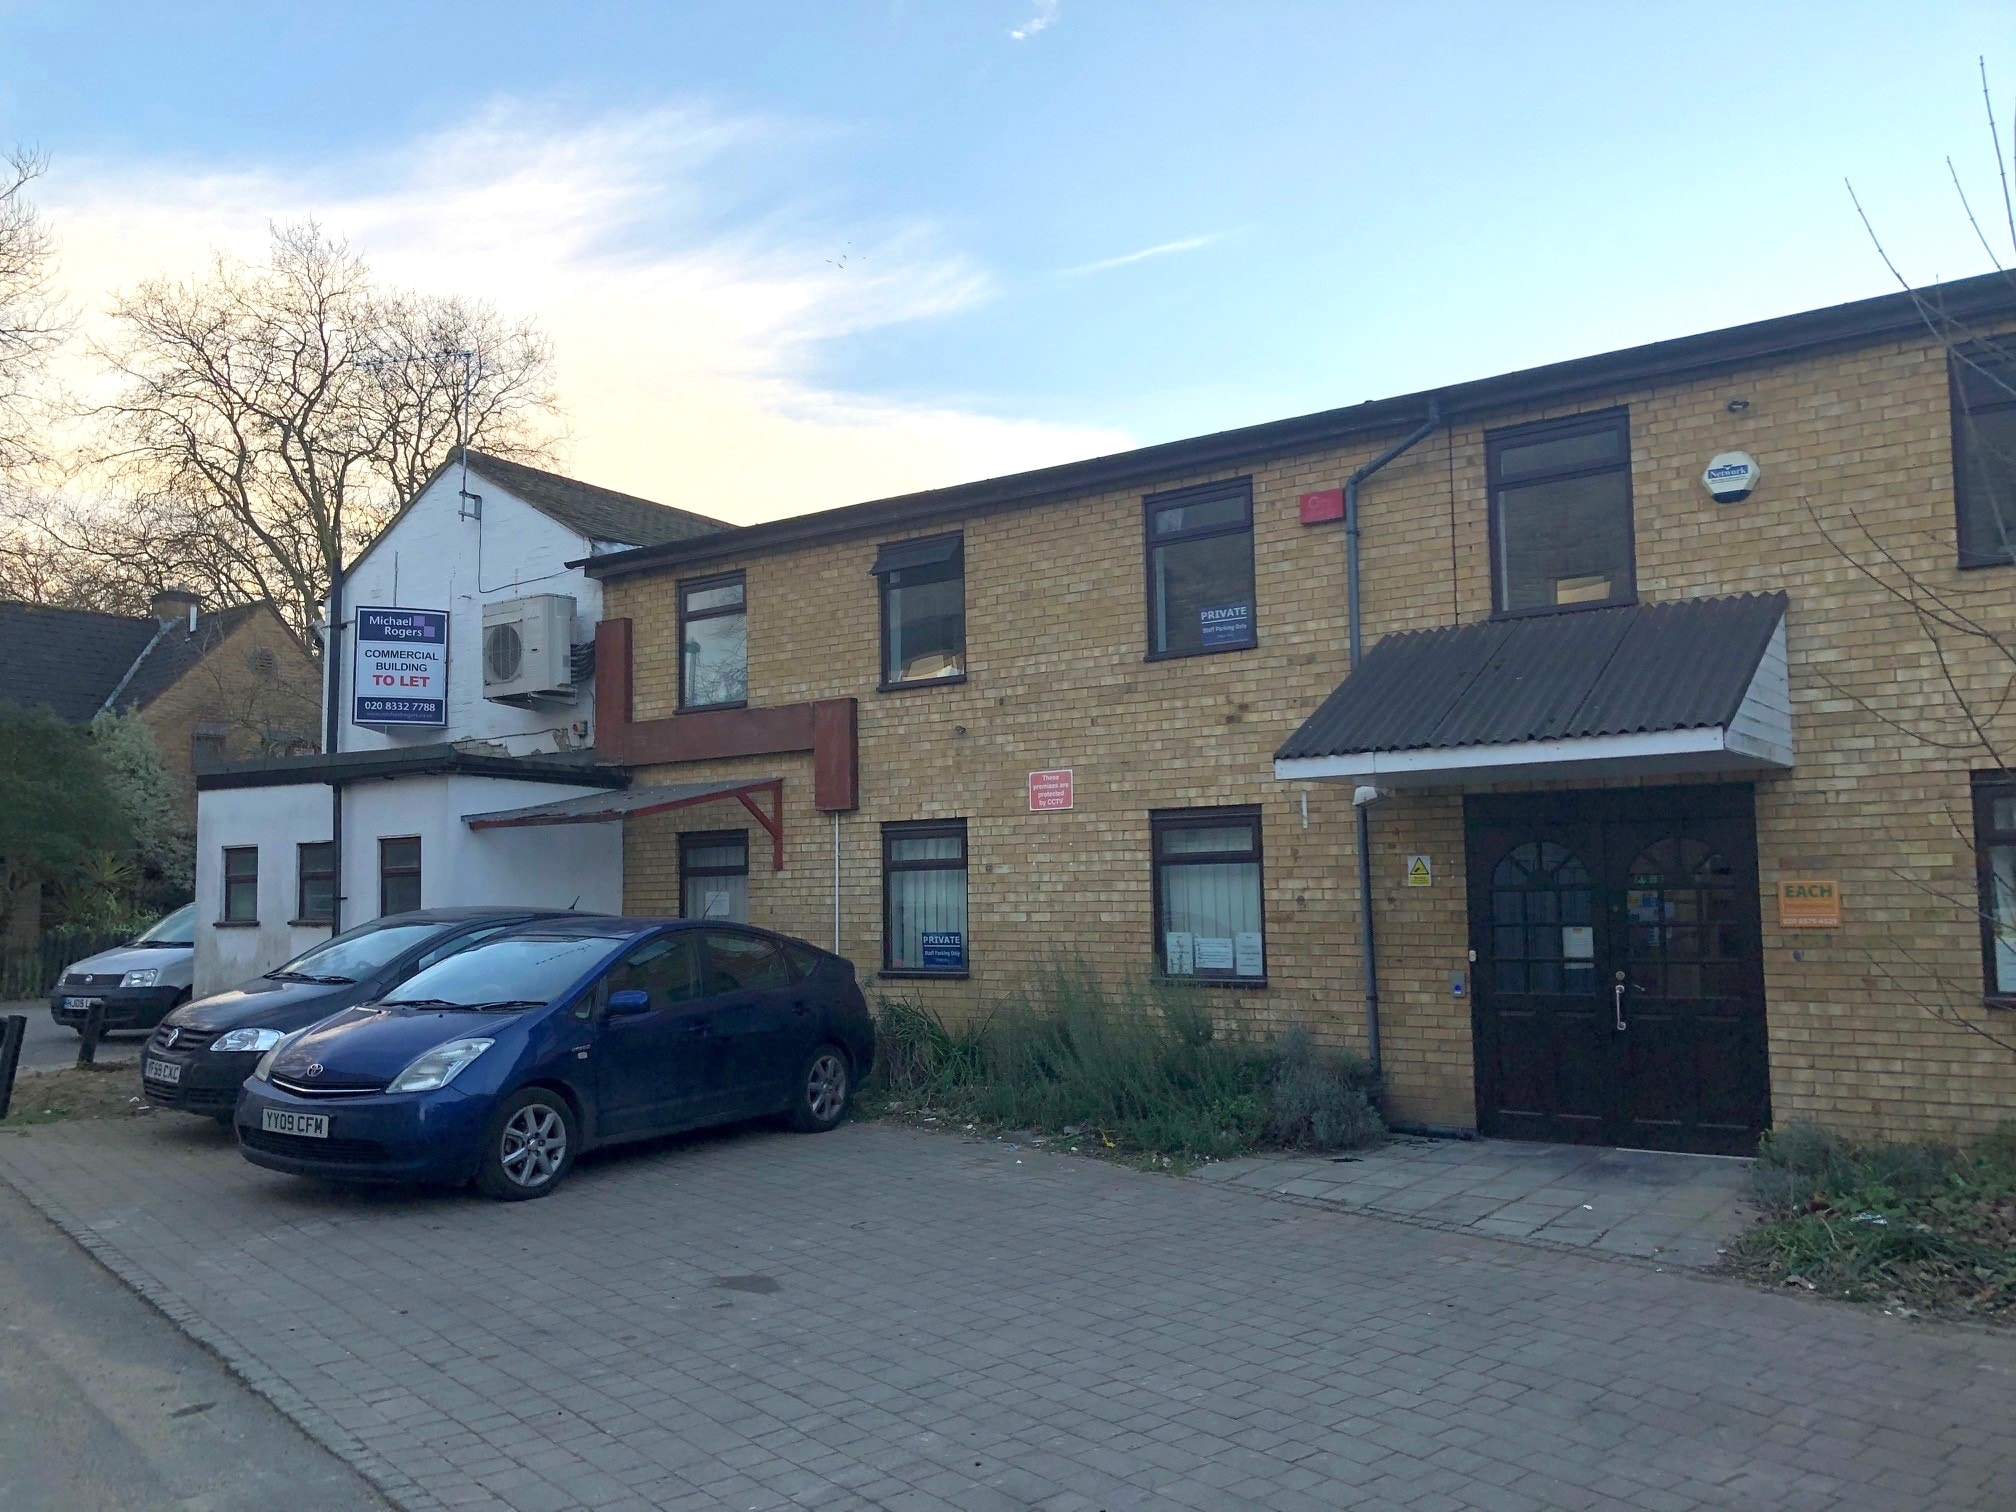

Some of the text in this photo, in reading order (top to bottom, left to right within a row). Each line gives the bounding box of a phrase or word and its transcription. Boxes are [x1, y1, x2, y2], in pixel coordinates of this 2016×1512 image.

[1709, 466, 1747, 478] Network
[1201, 606, 1247, 620] PRIVATE
[369, 615, 412, 626] Michael
[384, 626, 422, 638] Rogers
[365, 649, 439, 660] COMMERCIAL
[376, 662, 428, 672] BUILDING
[373, 674, 430, 687] TO LET
[365, 701, 436, 712] 020 8332 7788
[1033, 783, 1058, 791] premises
[1037, 790, 1064, 799] protected
[1785, 885, 1832, 898] EACH
[923, 936, 960, 944] PRIVATE
[266, 1111, 323, 1135] YY09 CFM
